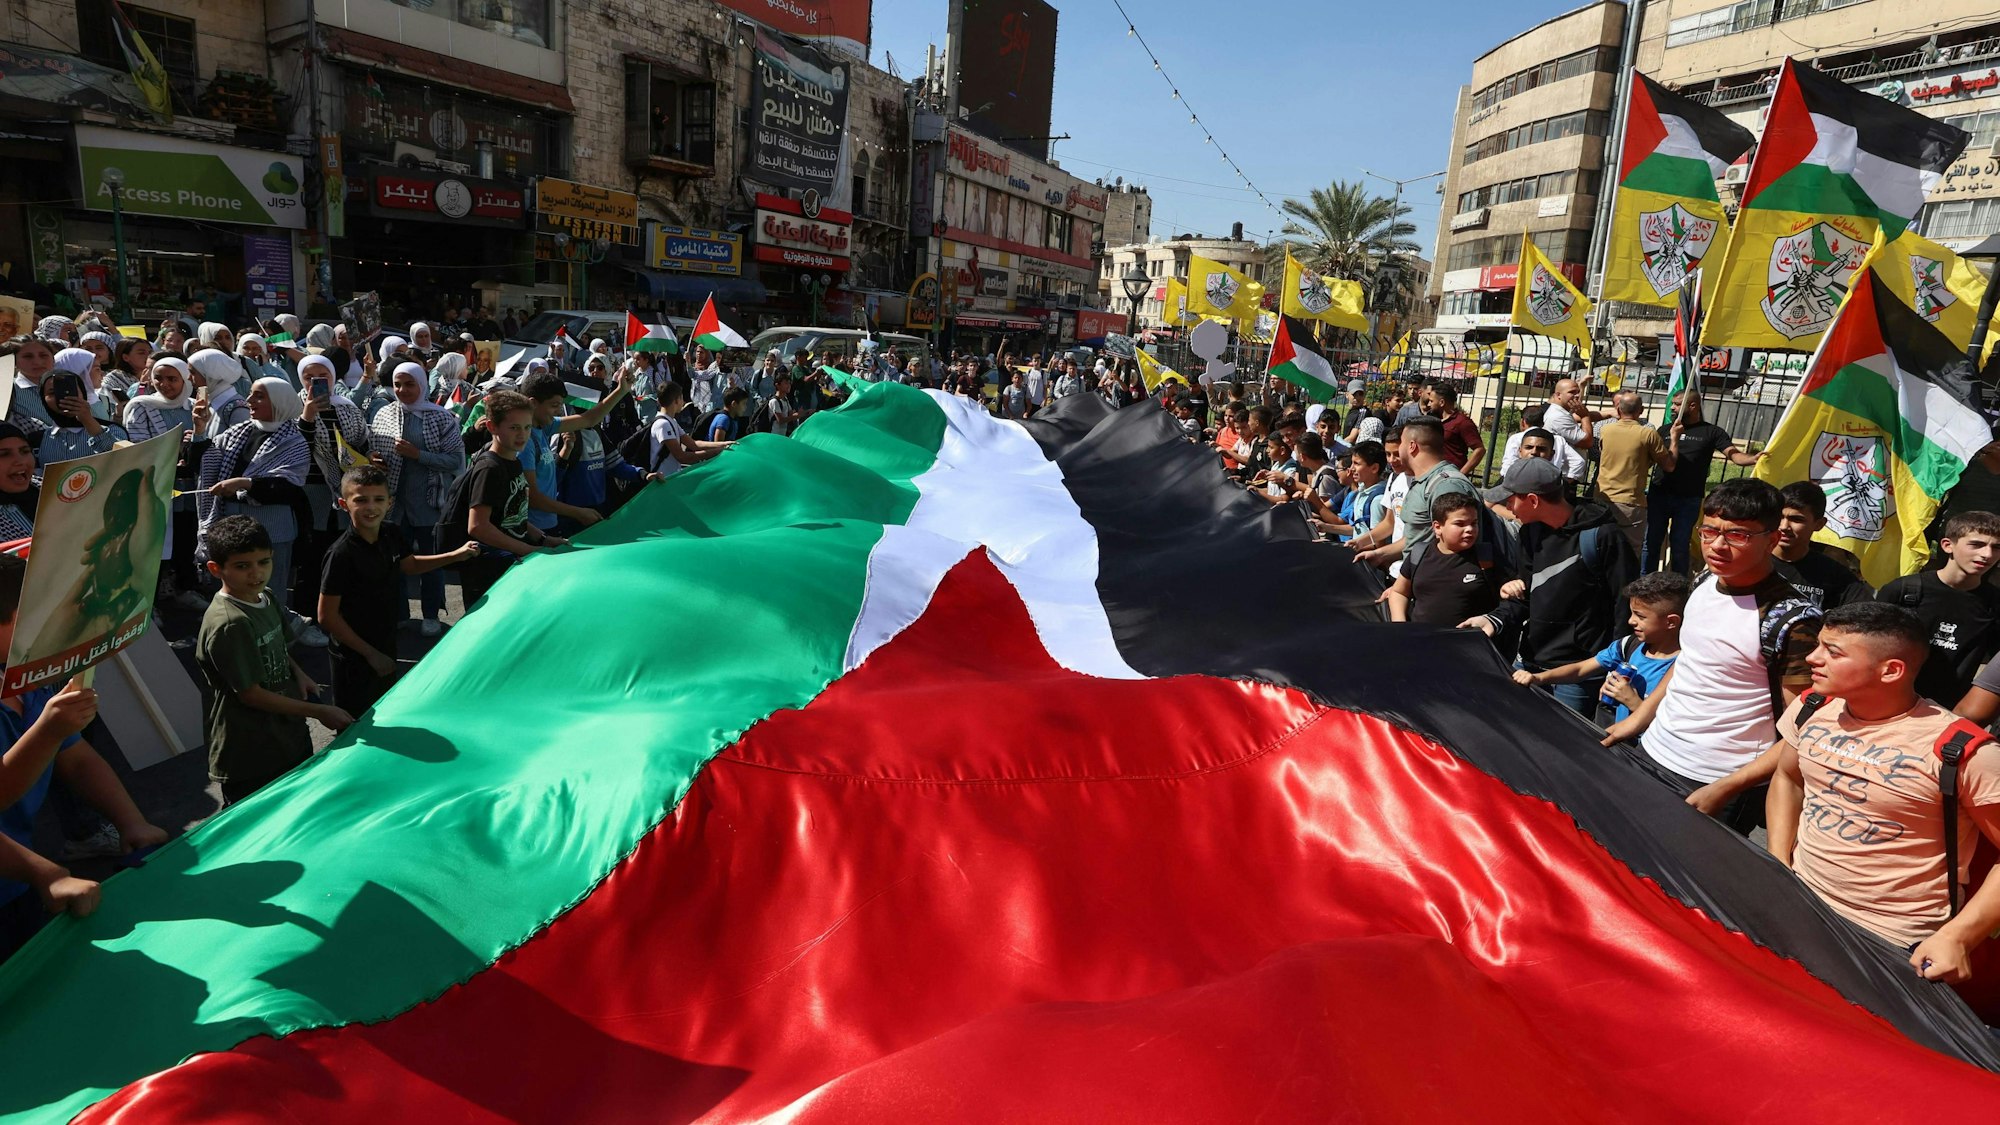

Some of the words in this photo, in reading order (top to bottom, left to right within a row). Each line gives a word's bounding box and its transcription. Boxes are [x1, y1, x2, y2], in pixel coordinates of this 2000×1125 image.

[762, 98, 803, 127] للبيع
[807, 104, 835, 136] مش
[778, 135, 800, 153] صفقة
[97, 182, 172, 204] Access
[177, 189, 242, 211] Phone
[267, 196, 297, 210] جوال
[384, 184, 428, 205] بيكر
[478, 192, 521, 210] مستر
[541, 192, 569, 207] السريعة
[547, 214, 622, 234] WESTERN
[571, 228, 622, 243] UNION
[670, 240, 702, 257] المأمون
[702, 242, 729, 259] مكتبة
[810, 224, 848, 251] شركة
[109, 612, 149, 650] اوقفوا
[81, 640, 109, 667] قتل
[10, 653, 80, 691] الاطفال
